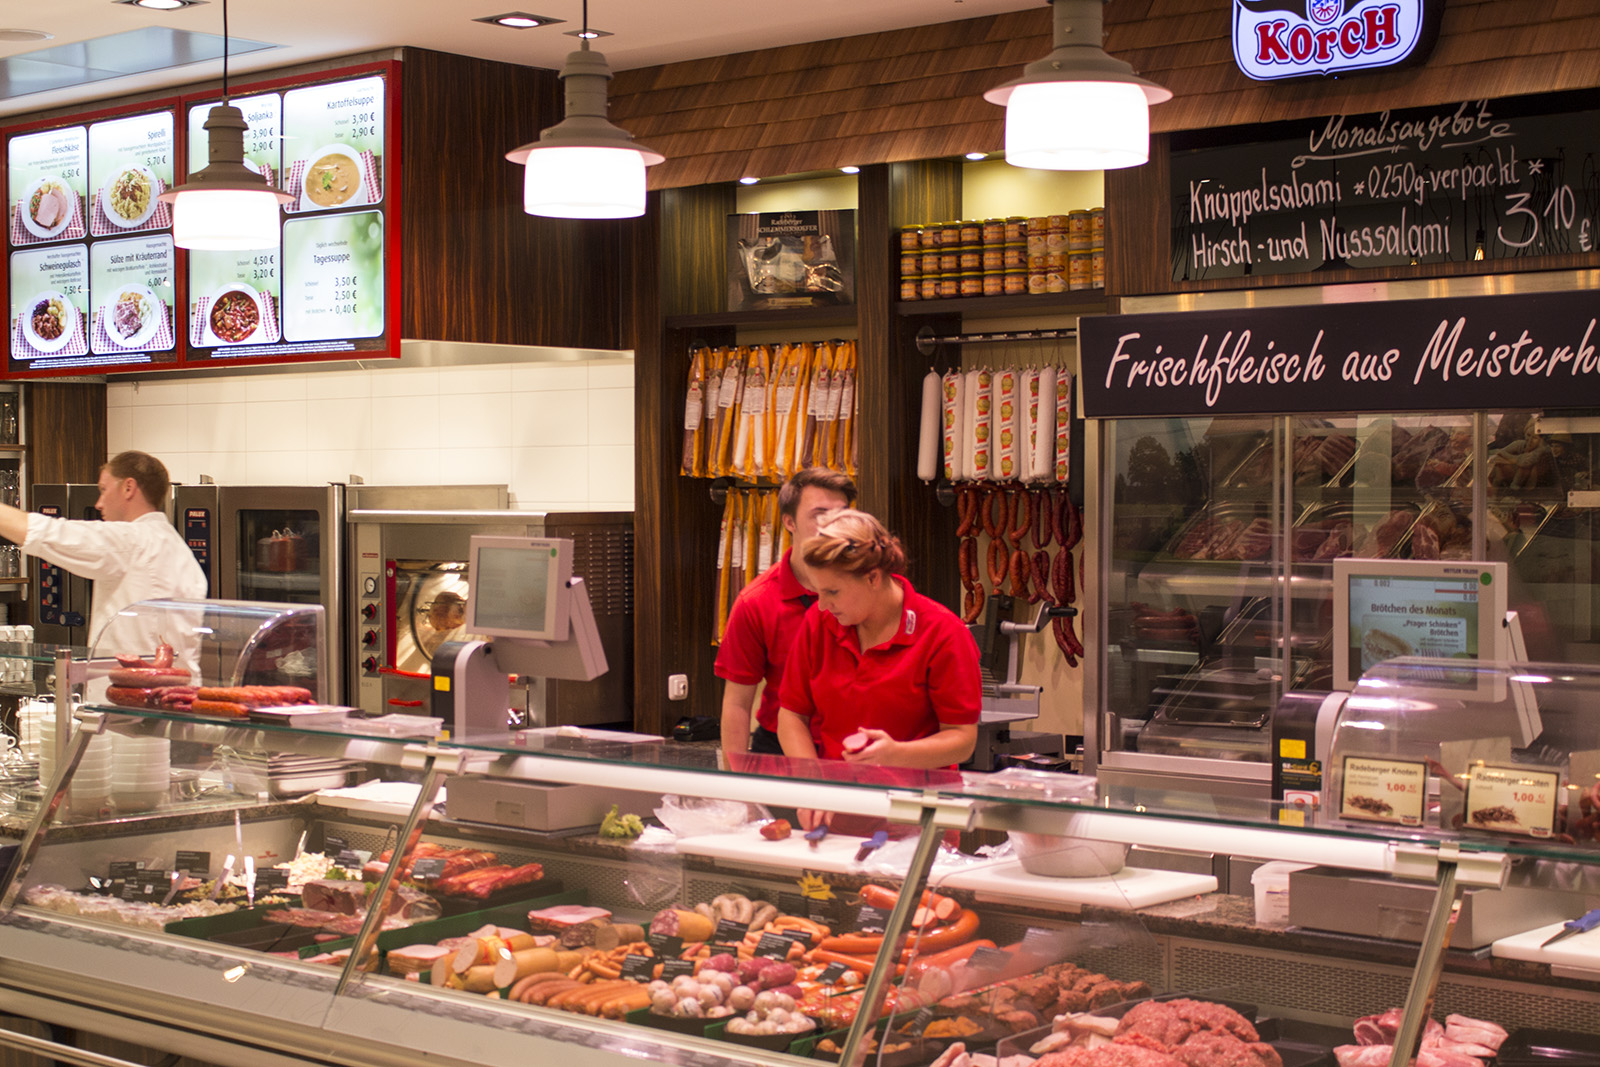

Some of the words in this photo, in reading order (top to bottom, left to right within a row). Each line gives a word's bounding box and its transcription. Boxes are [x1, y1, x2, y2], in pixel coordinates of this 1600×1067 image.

[327, 95, 374, 110] Kartoffelsuppe
[248, 110, 274, 122] Soljanka
[352, 113, 368, 125] 3,90
[370, 112, 375, 121] €
[1309, 98, 1493, 152] Monatsangebot
[252, 128, 268, 140] 3,90
[269, 128, 274, 136] €
[352, 128, 368, 139] 2,90
[370, 126, 375, 136] €
[252, 142, 268, 152] 2,90
[269, 140, 274, 150] €
[147, 156, 160, 167] 5,70
[162, 155, 166, 164] €
[62, 169, 74, 179] 6,50
[1190, 167, 1342, 227] Knüppelsalami
[1320, 206, 1450, 261] Nusssalami
[110, 254, 124, 264] Sülze
[125, 252, 134, 262] mit
[136, 250, 167, 261] Kräuterrand
[253, 256, 268, 266] 4,50
[270, 255, 274, 264] €
[313, 253, 350, 266] Tagessuppe
[40, 259, 81, 272] Schweinegulasch
[253, 269, 268, 280] 3,20
[270, 268, 274, 277] €
[148, 277, 162, 288] 6,00
[335, 276, 351, 288] 3,50
[352, 276, 357, 286] €
[64, 285, 76, 296] 7,50
[335, 290, 351, 301] 2,50
[352, 290, 357, 299] €
[336, 305, 352, 315] 0,40
[352, 304, 357, 313] €
[1105, 329, 1326, 407] Frischfleisch
[1341, 348, 1400, 382] aus
[1413, 316, 1600, 386] Meisterh
[1371, 604, 1407, 614] Brötchen
[1409, 604, 1424, 615] des
[1425, 606, 1457, 616] Monats
[1350, 764, 1390, 775] Radeberger
[1392, 768, 1418, 776] Knoten
[1476, 773, 1519, 786] Radeberger
[1387, 782, 1406, 792] 1,00
[1513, 792, 1534, 802] 1,00
